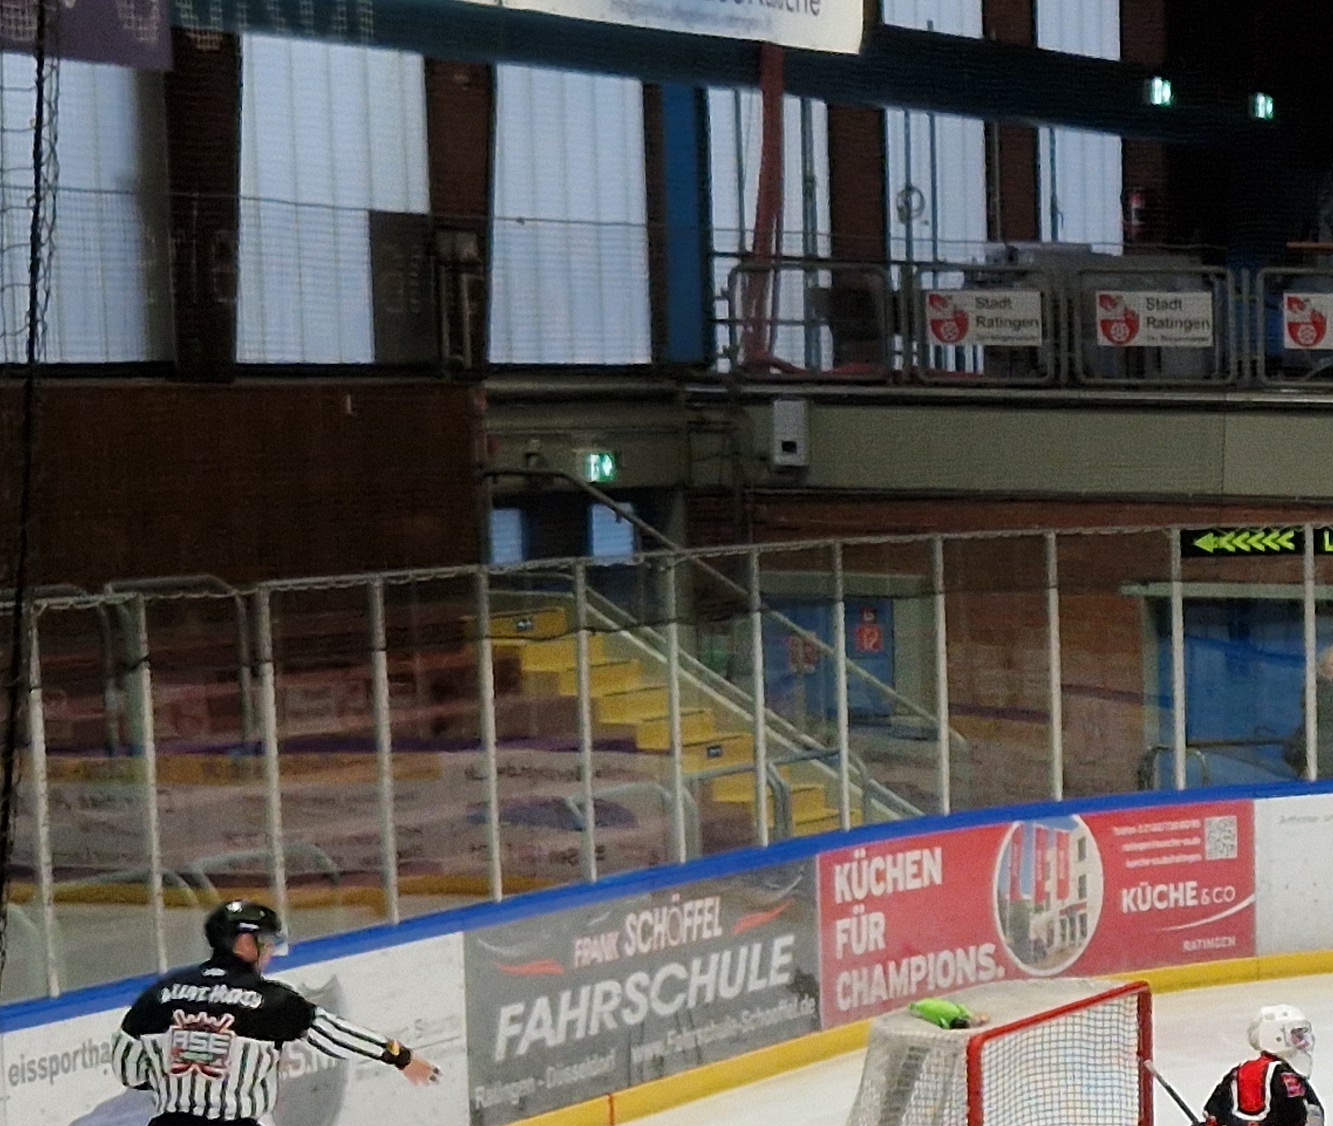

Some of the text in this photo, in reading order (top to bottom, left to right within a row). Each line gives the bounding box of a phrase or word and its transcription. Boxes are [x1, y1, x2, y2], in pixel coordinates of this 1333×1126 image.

[975, 297, 1011, 309] Stadt
[975, 316, 1039, 332] Ratingen
[1145, 297, 1182, 311] Stadt
[1146, 317, 1210, 333] Ratingen
[834, 846, 942, 904] KÜCHEN
[573, 893, 723, 968] FRANK SCHÖFFEL
[835, 903, 886, 960] FÜR
[495, 935, 795, 1062] FAHRSCHULE
[836, 943, 1005, 1011] CHAMPIONS.
[7, 1042, 112, 1087] eissportha
